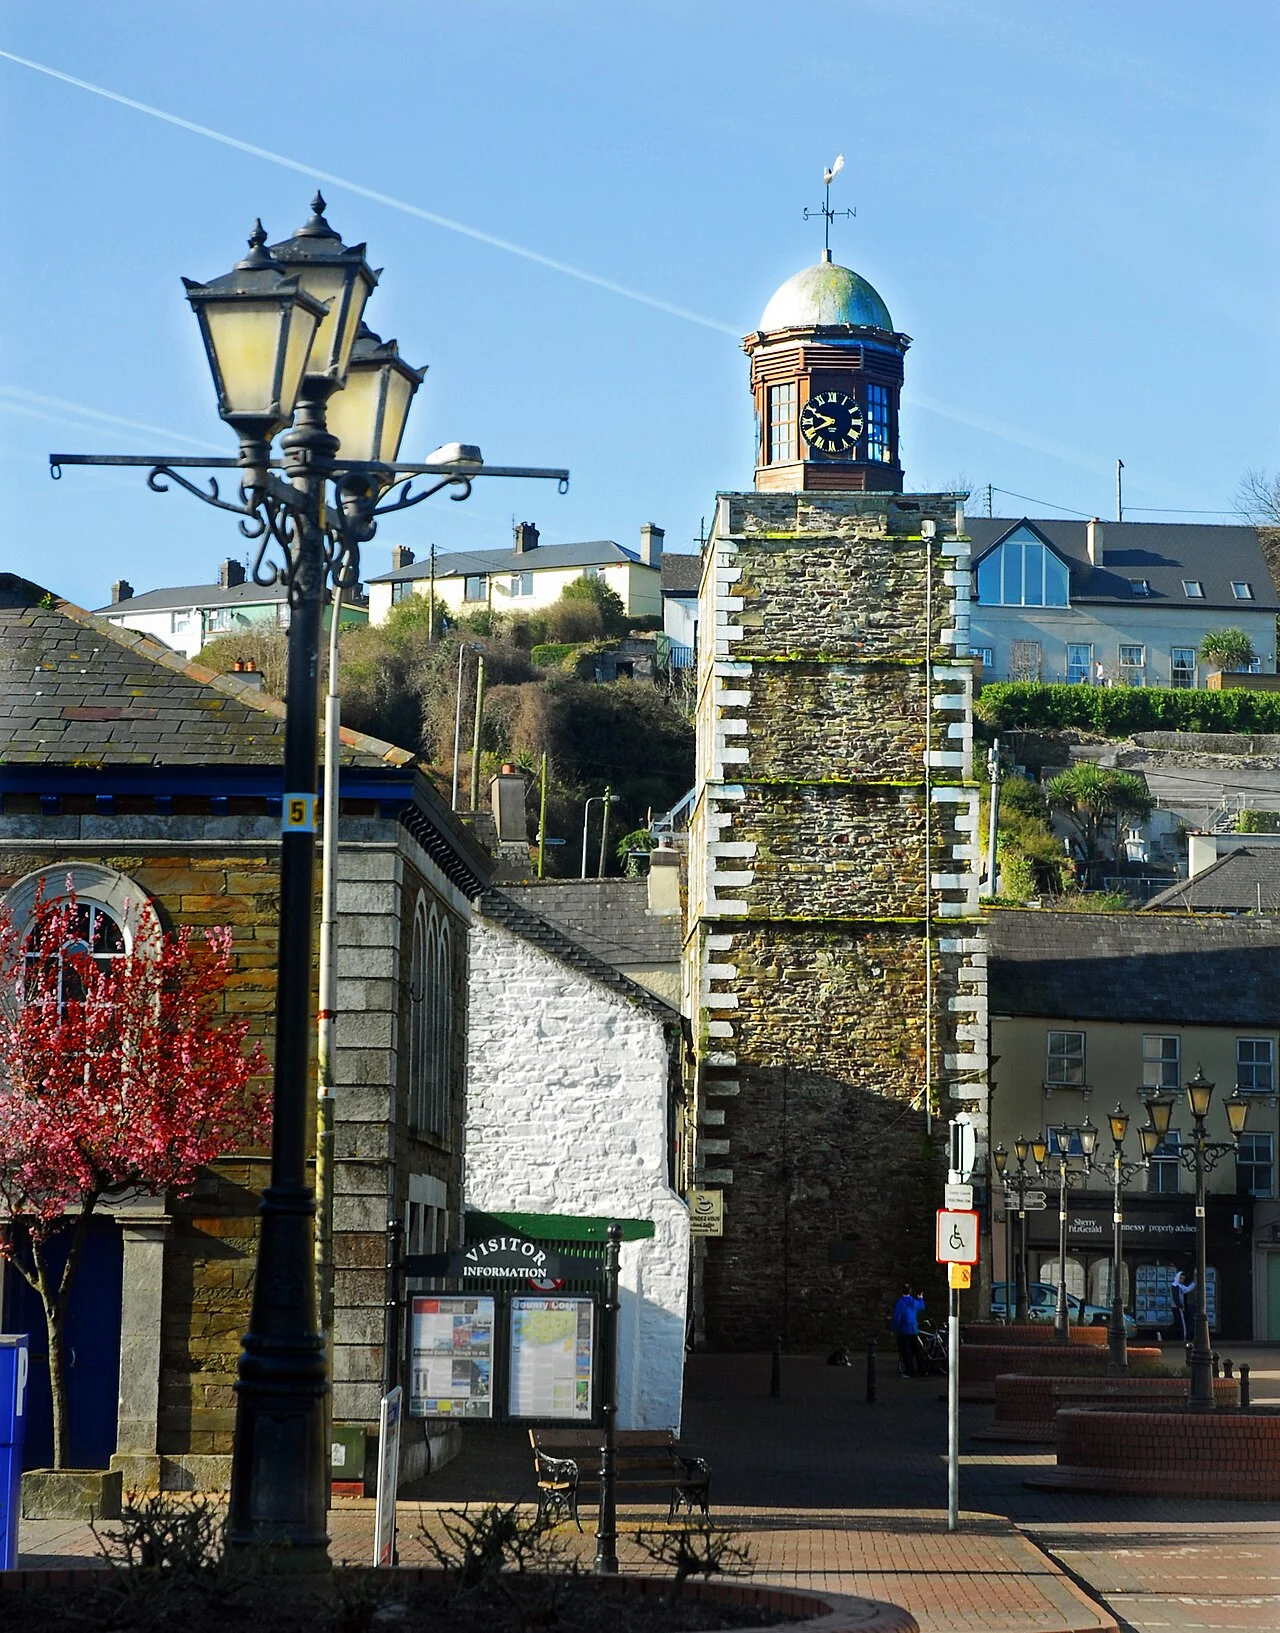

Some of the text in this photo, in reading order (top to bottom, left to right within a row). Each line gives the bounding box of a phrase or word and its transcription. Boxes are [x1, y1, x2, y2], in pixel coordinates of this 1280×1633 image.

[291, 801, 303, 822] 5
[1074, 1218, 1097, 1226] Sherry
[1148, 1224, 1174, 1234] property
[465, 1237, 547, 1267] VISITOR
[463, 1266, 547, 1278] INFORMATION
[512, 1300, 548, 1311] County
